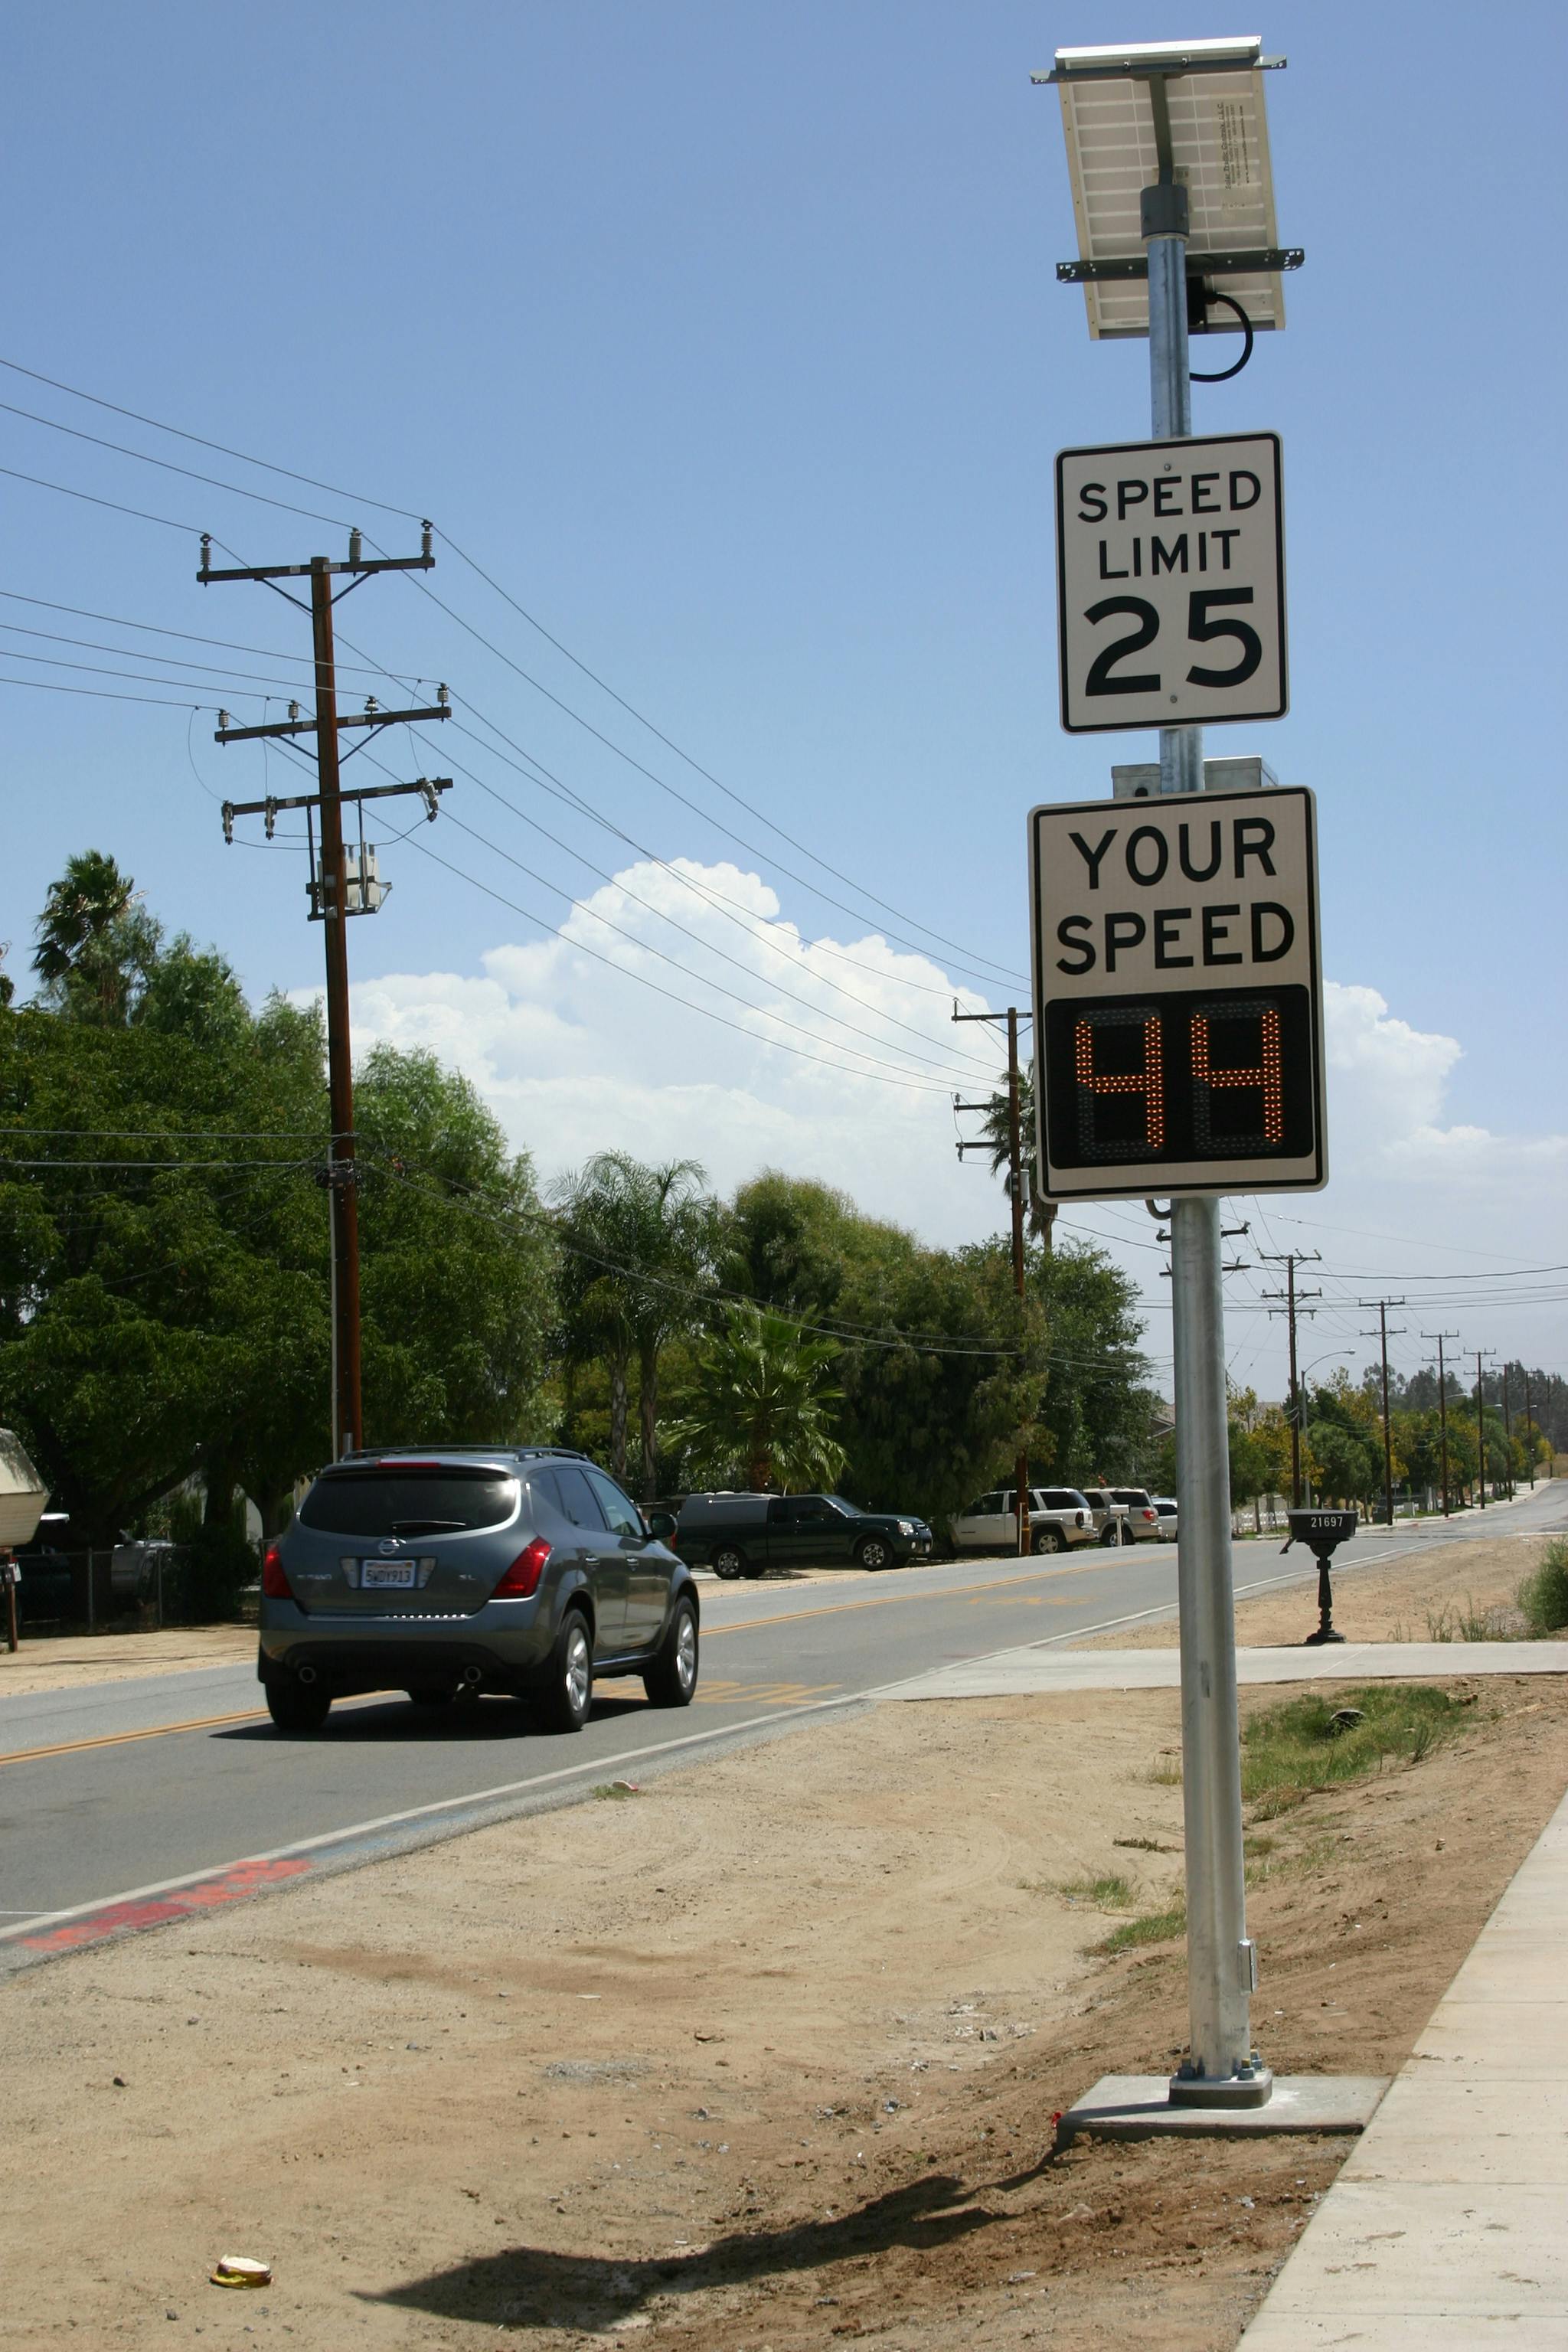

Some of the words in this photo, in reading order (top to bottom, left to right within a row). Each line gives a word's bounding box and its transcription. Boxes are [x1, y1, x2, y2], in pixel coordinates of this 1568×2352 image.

[1078, 470, 1261, 523] SPEED
[1099, 529, 1240, 580] LIMIT
[1083, 586, 1262, 696] 25
[1068, 817, 1276, 890] YOUR
[1056, 901, 1295, 975] SPEED
[1075, 1010, 1283, 1148] 44
[1311, 1517, 1343, 1527] 21697
